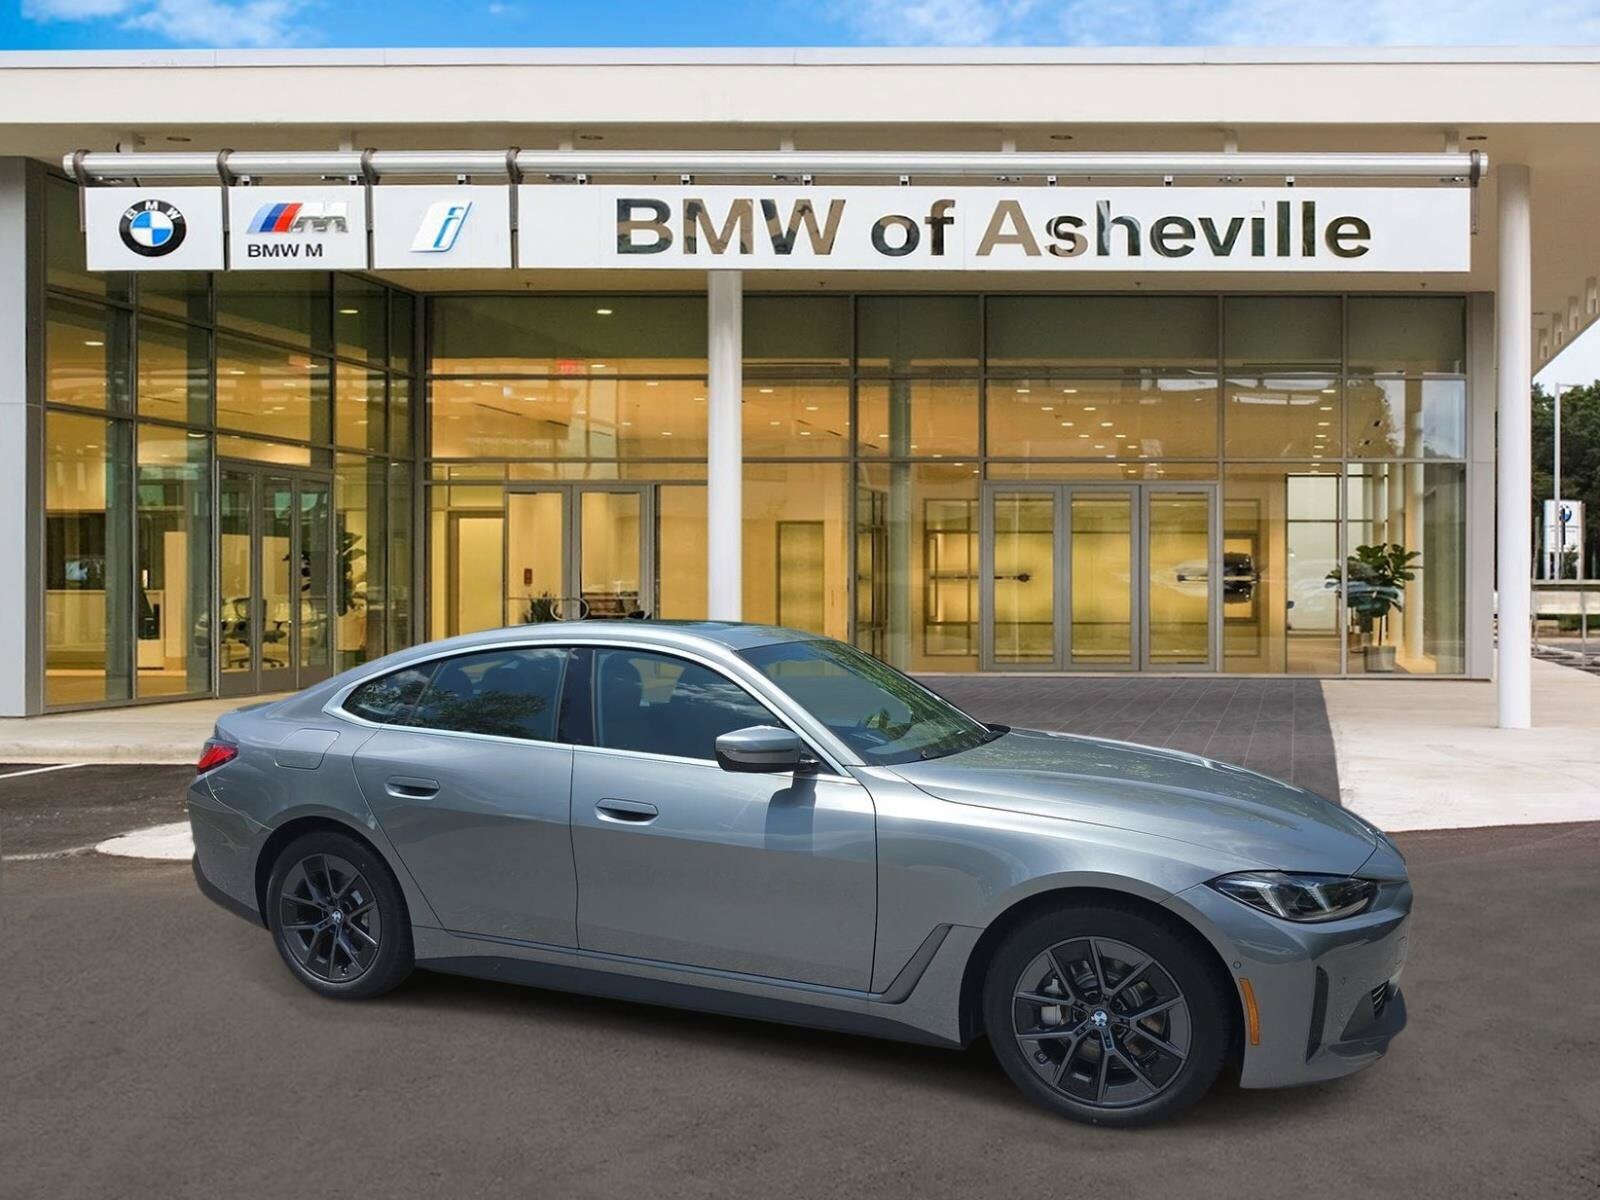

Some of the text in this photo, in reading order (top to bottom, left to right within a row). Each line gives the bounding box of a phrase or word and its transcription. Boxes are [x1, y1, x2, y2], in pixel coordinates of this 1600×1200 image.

[124, 200, 182, 220] BMW
[616, 197, 1372, 259] BMW of Asheville
[247, 243, 323, 258] BMW M
